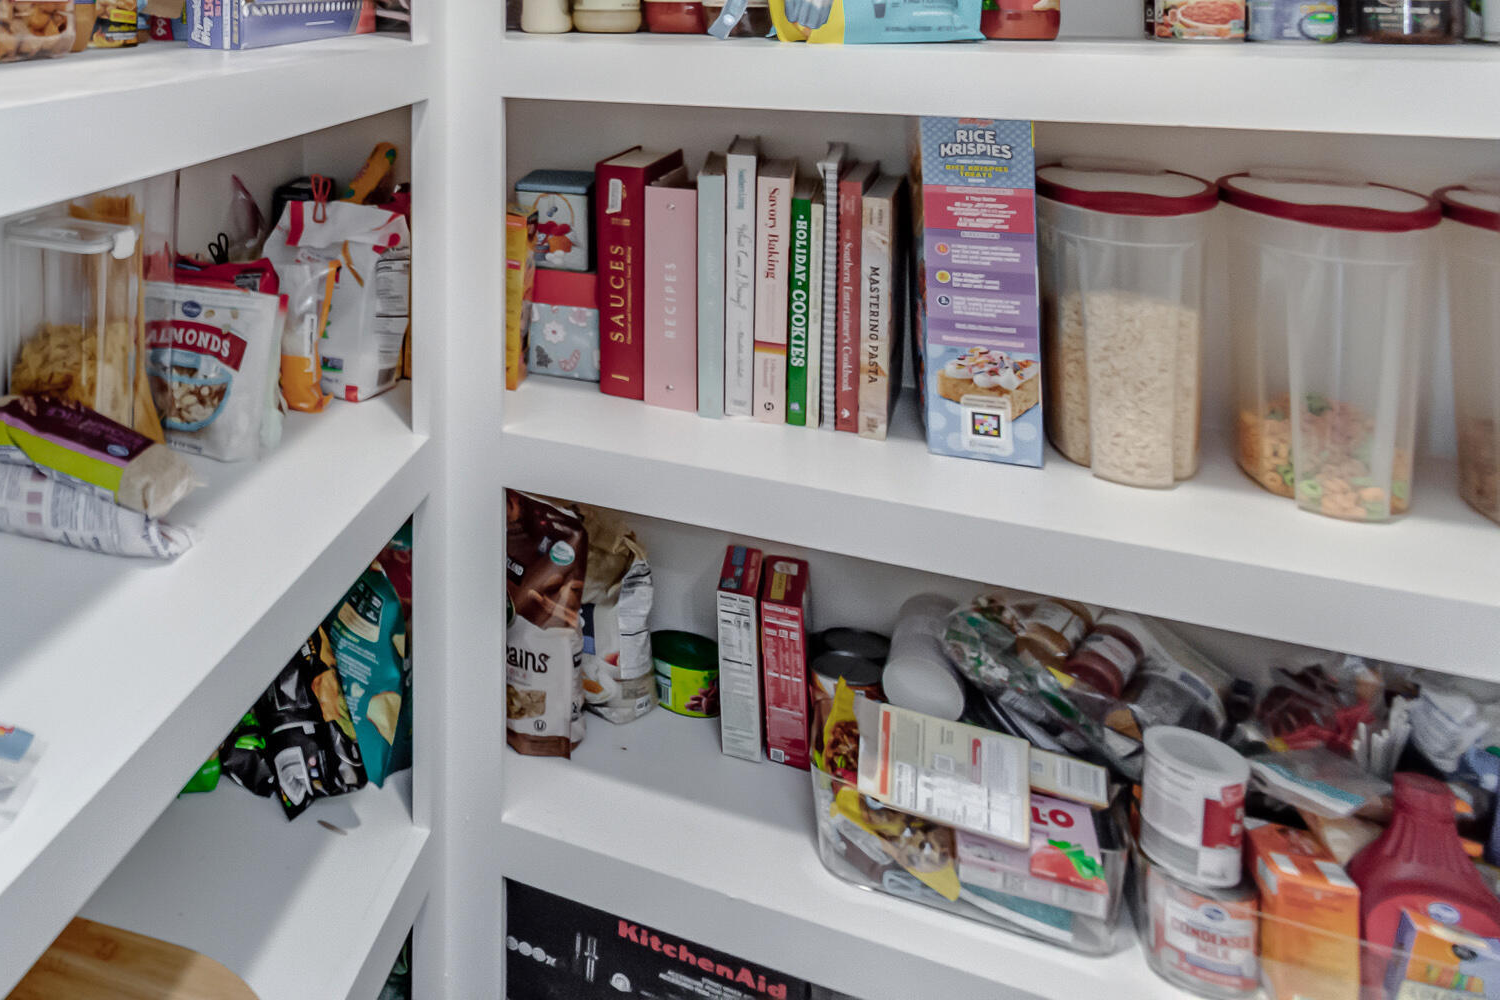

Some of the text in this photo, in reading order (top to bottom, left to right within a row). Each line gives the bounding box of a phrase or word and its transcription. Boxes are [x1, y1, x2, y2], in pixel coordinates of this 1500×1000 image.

[939, 144, 1012, 160] KRISPIES
[956, 129, 996, 144] RICE
[764, 187, 779, 280] Savory Baking
[842, 242, 853, 282] Southern
[609, 244, 627, 343] SAUCES
[665, 261, 678, 339] RECIPES
[790, 288, 806, 367] COOKIES
[867, 266, 880, 384] MASTERING PASTA
[146, 322, 232, 360] ALMONDS
[840, 345, 853, 391] Cookbook
[617, 919, 788, 998] KitchenAid
